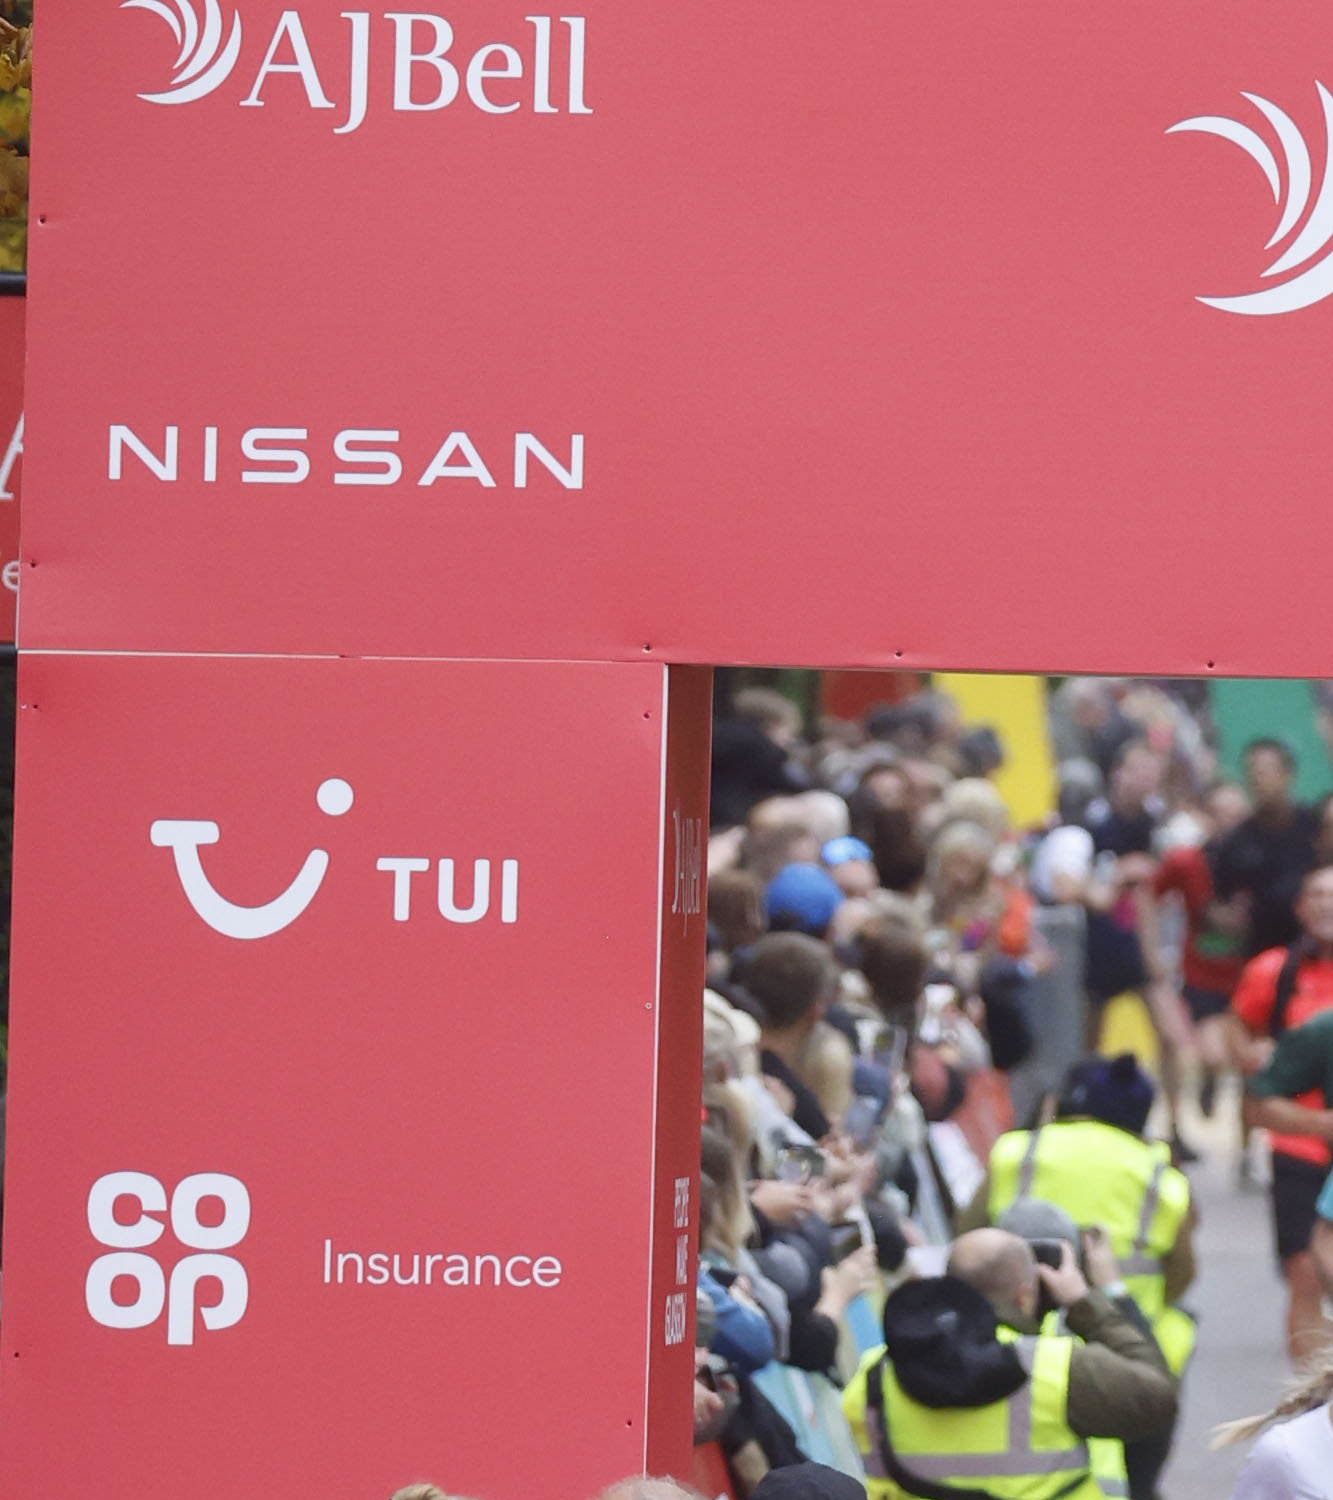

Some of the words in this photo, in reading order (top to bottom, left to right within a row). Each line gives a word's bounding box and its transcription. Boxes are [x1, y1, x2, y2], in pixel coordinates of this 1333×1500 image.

[108, 425, 584, 490] NISSAN
[376, 857, 519, 923] TUI
[323, 1238, 562, 1288] Insurance
